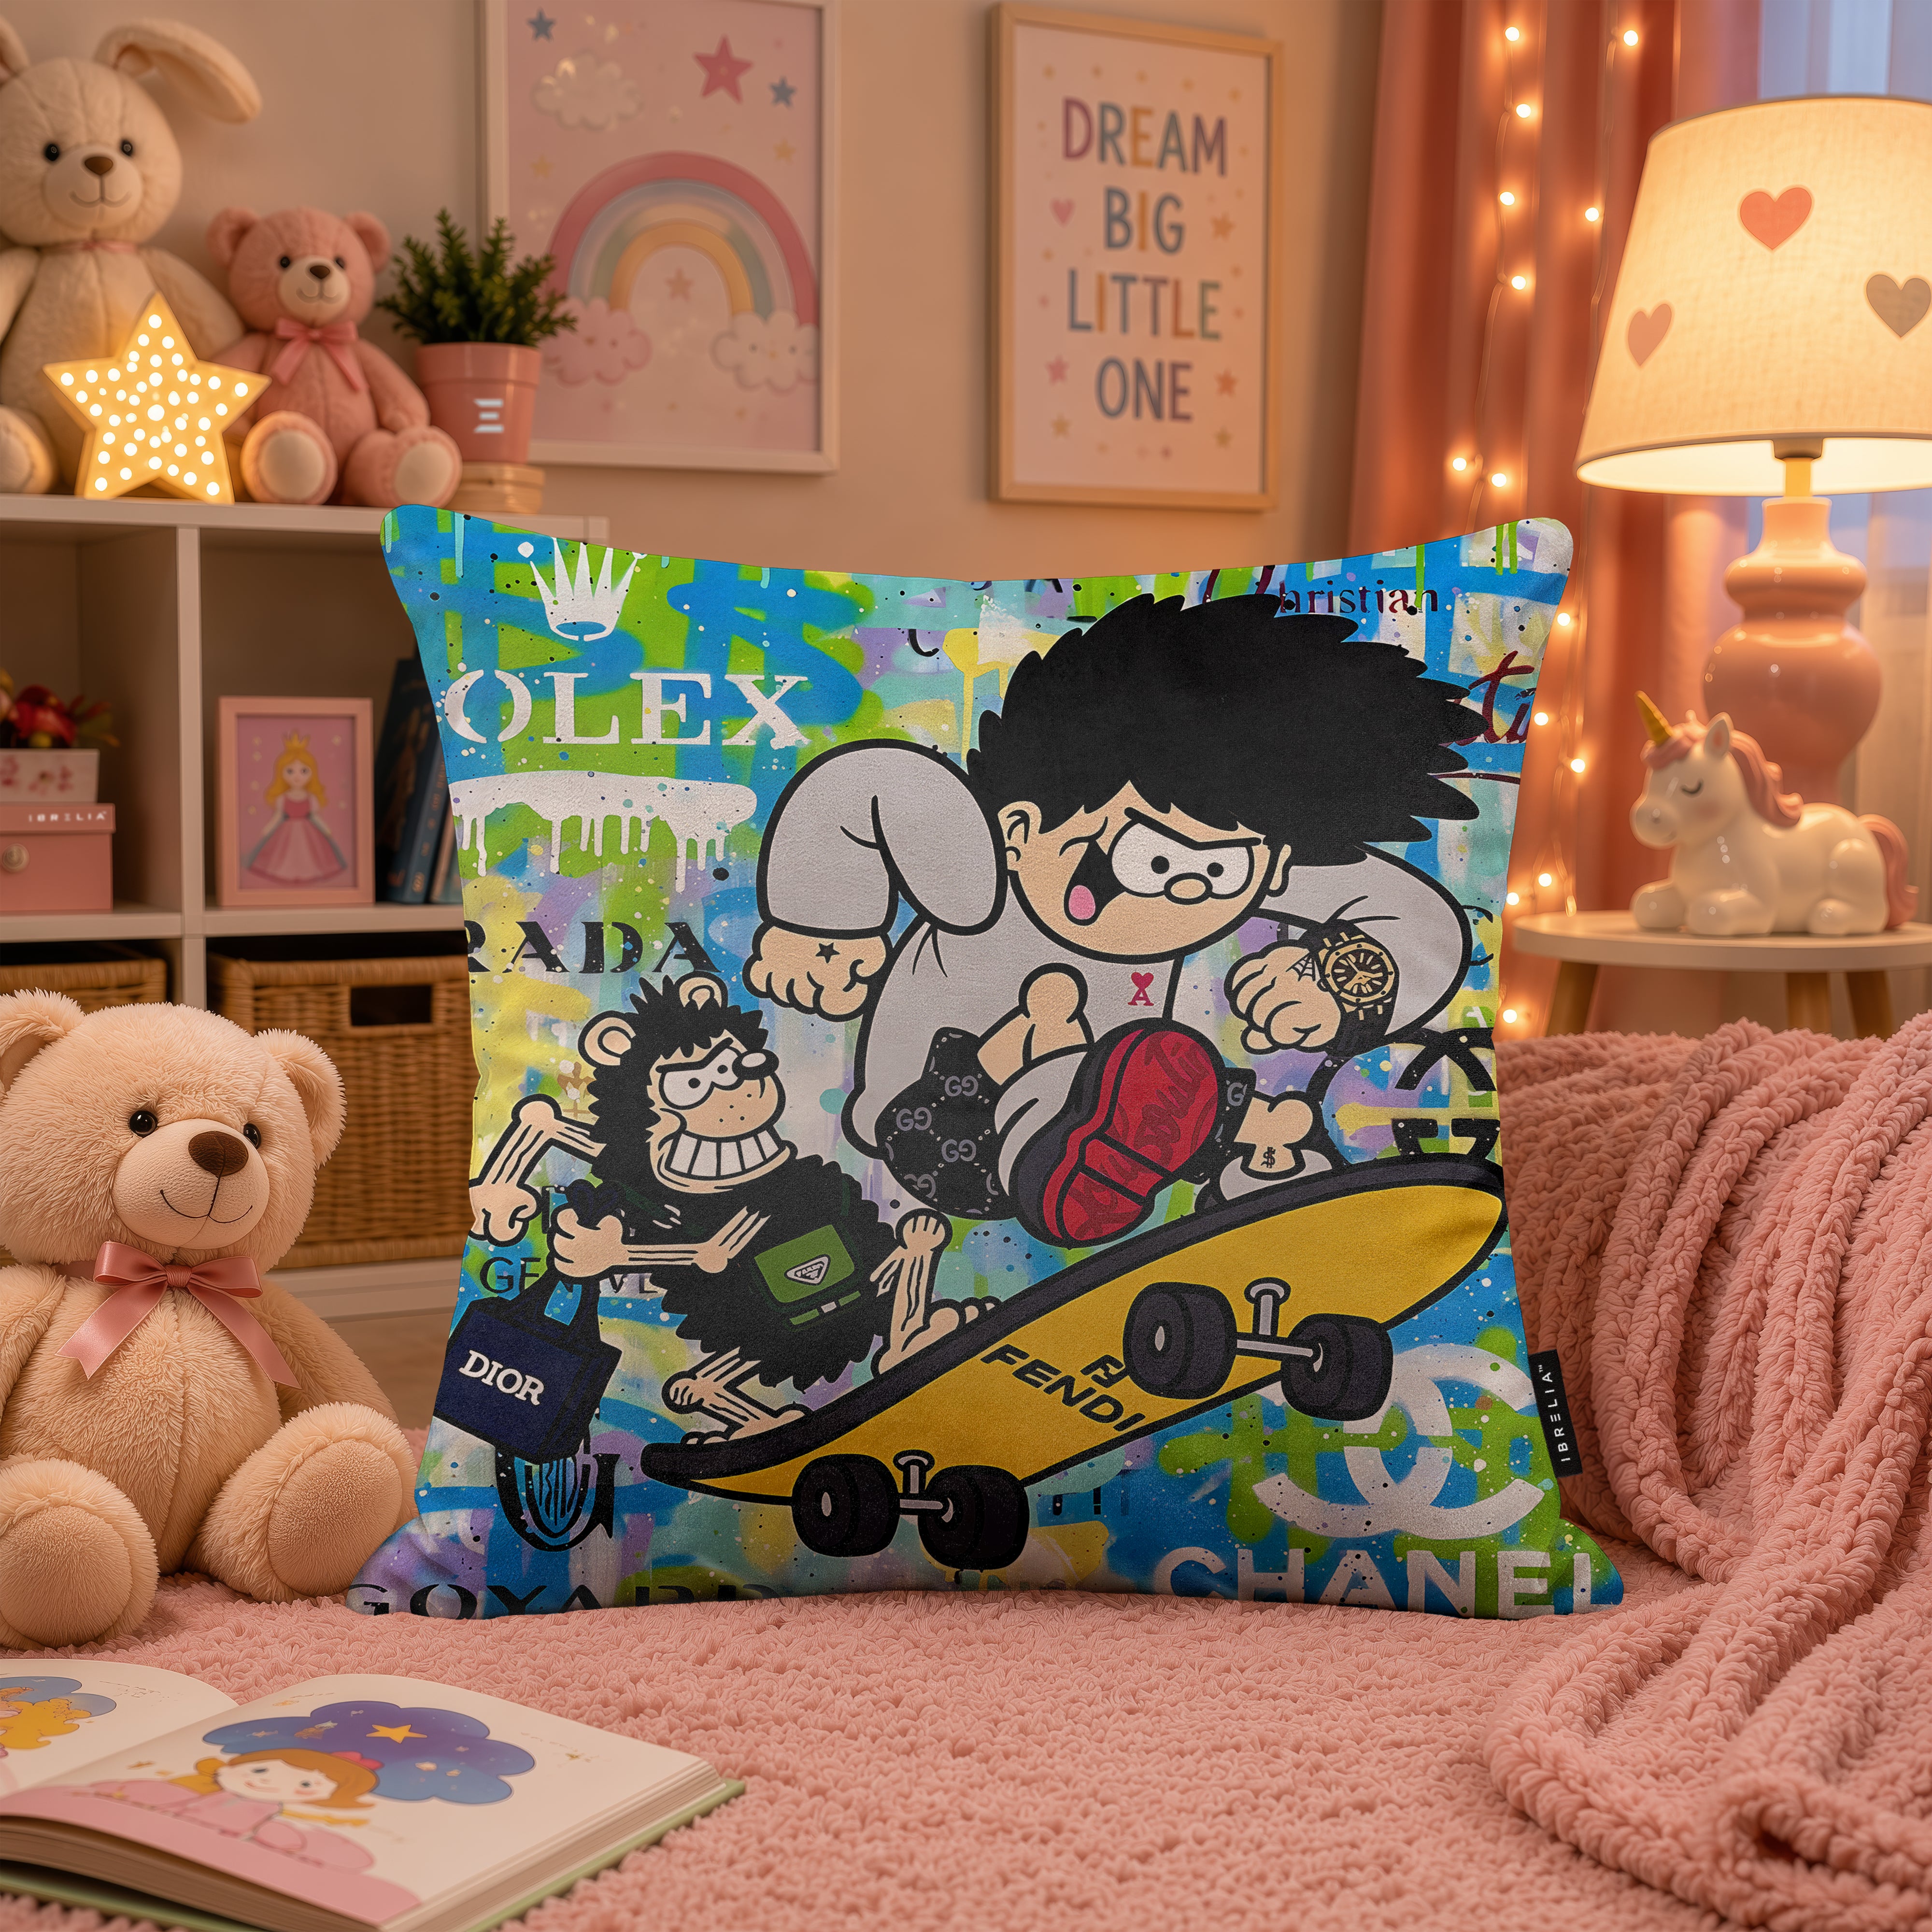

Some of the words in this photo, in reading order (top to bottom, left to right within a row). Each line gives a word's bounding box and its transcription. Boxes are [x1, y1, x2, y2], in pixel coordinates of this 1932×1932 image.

[1064, 98, 1228, 177] DREAM
[1105, 187, 1185, 254] BIG
[1068, 269, 1222, 341] LITTLE
[1096, 356, 1192, 422] ONE
[459, 1350, 544, 1406] DIOR
[980, 1344, 1146, 1432] FENDI
[1152, 1546, 1619, 1619] CHANEL
